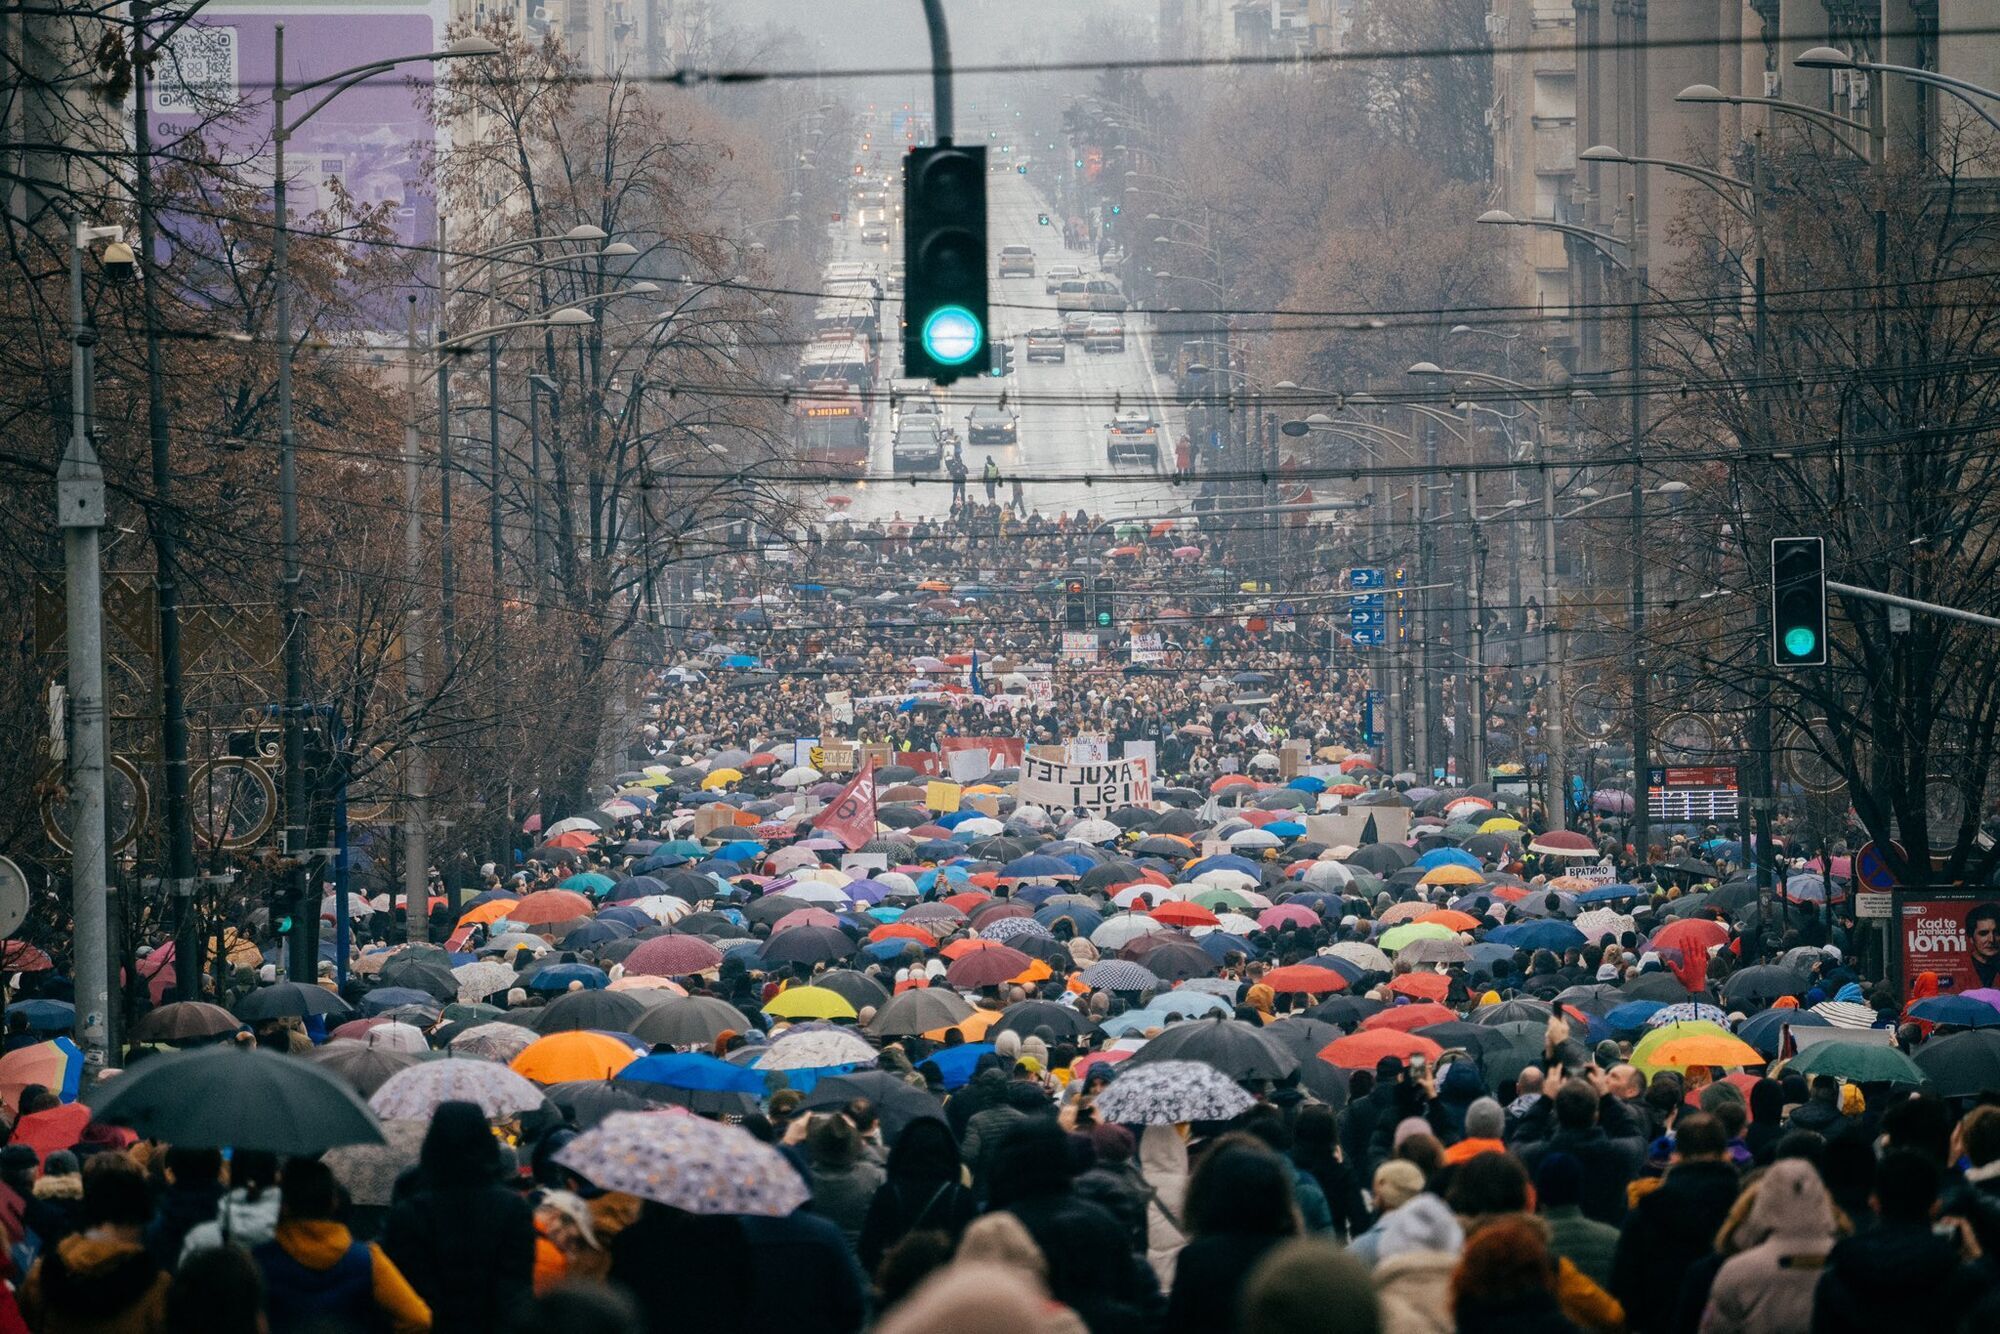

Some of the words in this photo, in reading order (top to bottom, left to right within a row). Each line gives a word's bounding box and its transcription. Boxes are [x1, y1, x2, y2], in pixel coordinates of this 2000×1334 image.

[1569, 866, 1609, 878] ВРАТИМО
[1917, 918, 1943, 929] Kad
[1944, 919, 1957, 929] te
[1917, 927, 1956, 938] prehlada
[1908, 928, 1967, 952] lomi
